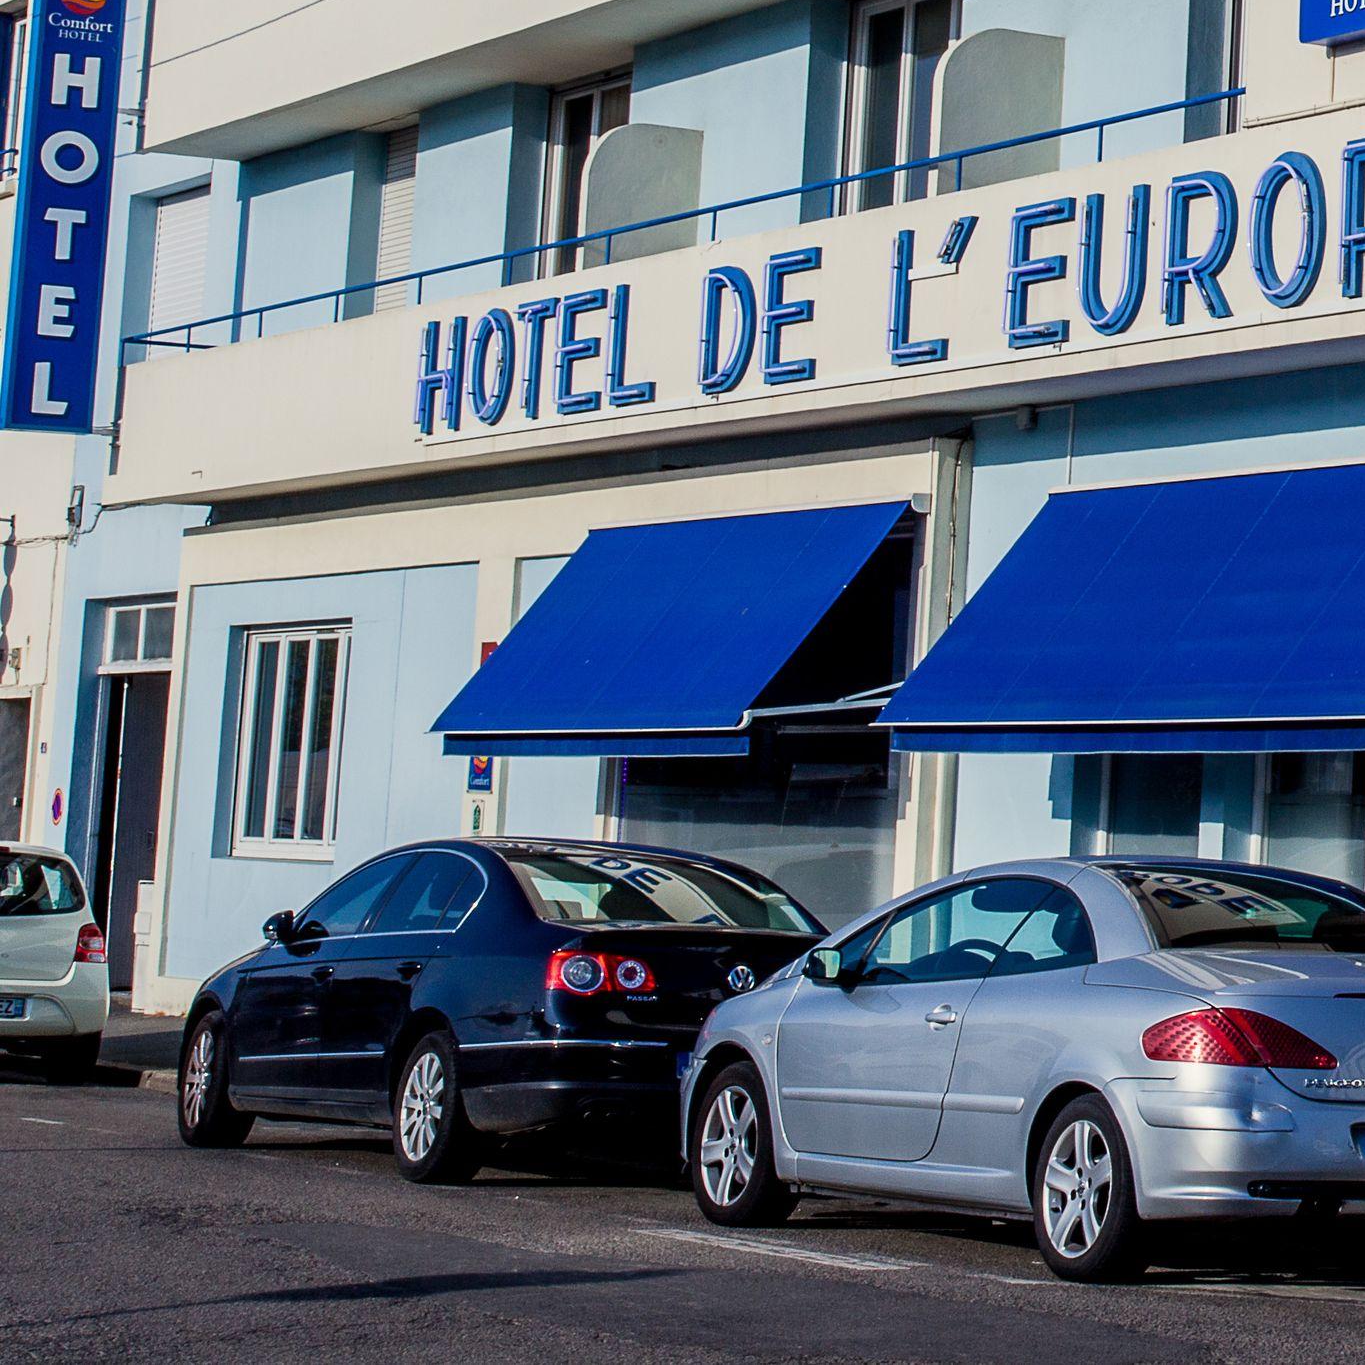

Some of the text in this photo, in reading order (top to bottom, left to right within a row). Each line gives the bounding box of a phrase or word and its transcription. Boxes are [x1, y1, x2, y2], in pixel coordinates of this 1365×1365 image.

[48, 11, 114, 33] Comfort
[58, 28, 104, 43] HOTEL
[30, 53, 101, 416] HOTEL
[413, 282, 657, 437] HOTEL
[700, 246, 822, 395] DE
